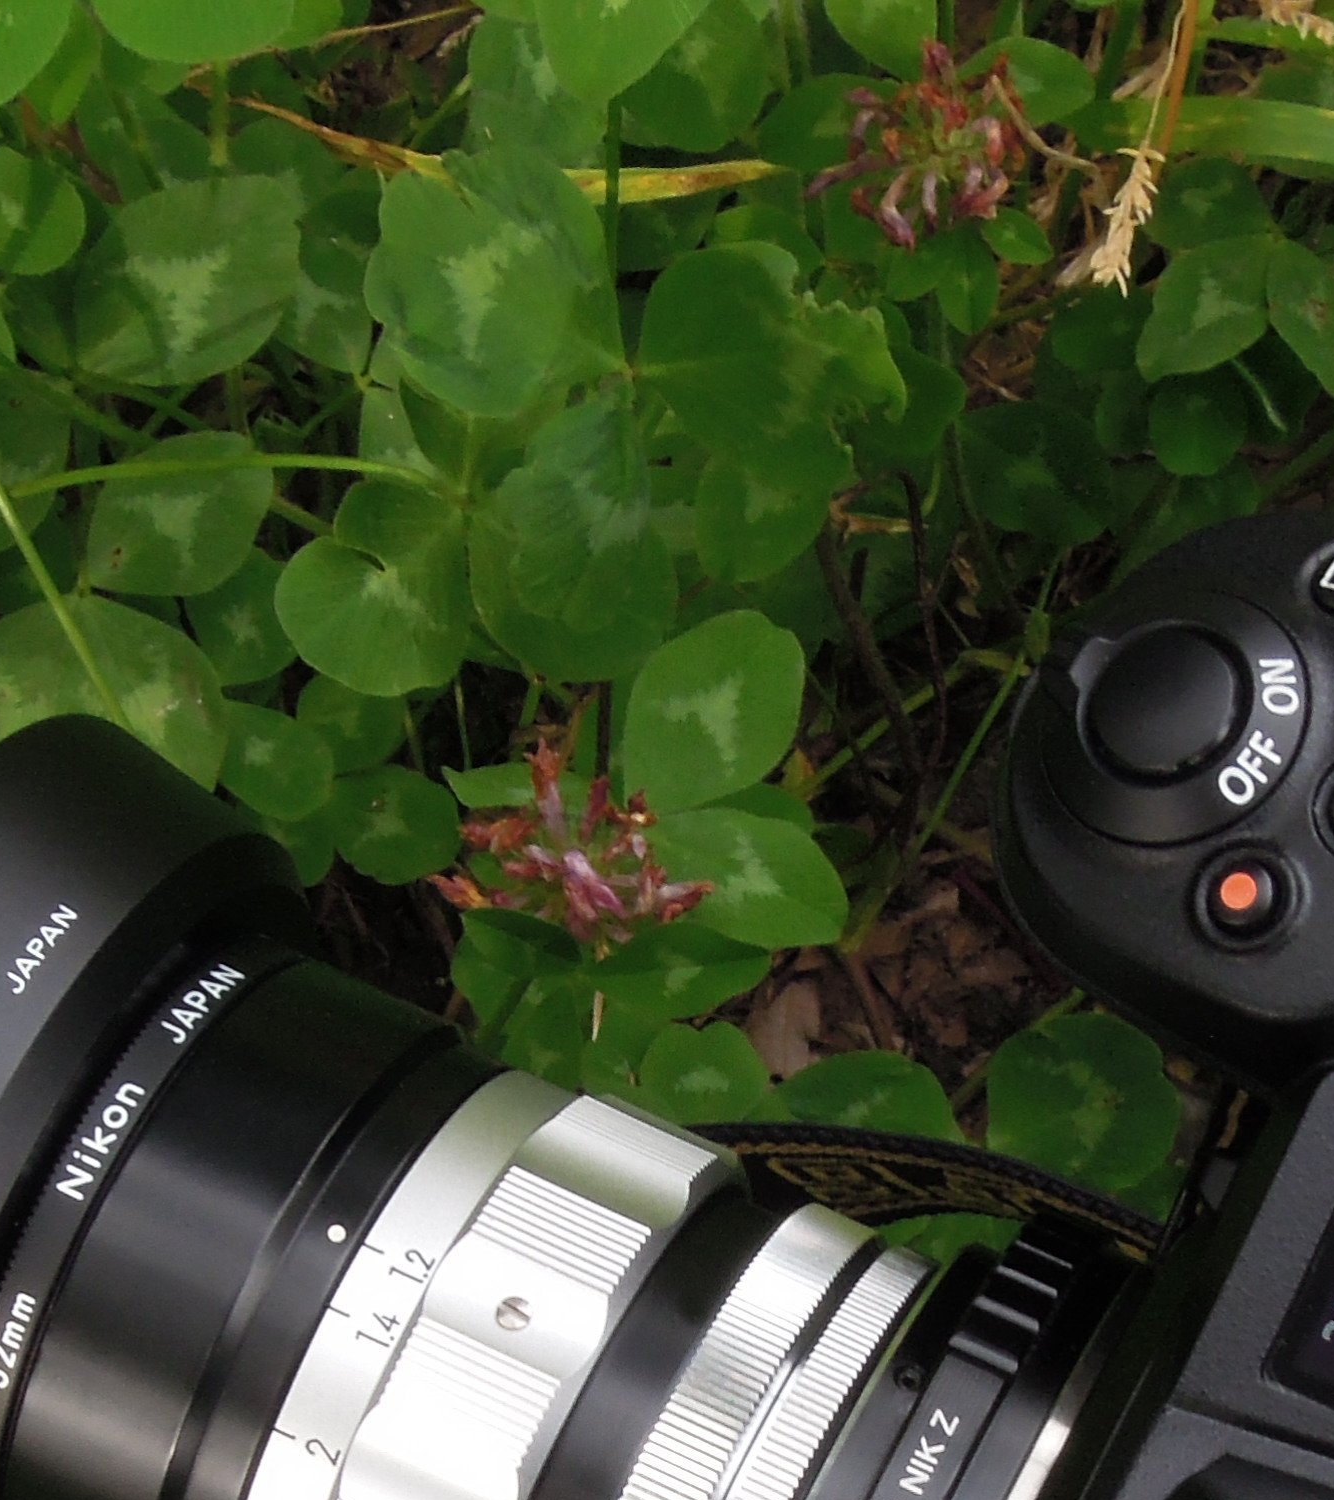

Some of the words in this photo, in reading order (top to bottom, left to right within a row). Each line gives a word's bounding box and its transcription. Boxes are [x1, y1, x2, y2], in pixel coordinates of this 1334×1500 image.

[1259, 658, 1300, 716] ON
[1218, 730, 1282, 805] OFF
[6, 904, 78, 995] JAPAN
[162, 963, 245, 1044] JAPAN
[55, 1082, 146, 1201] Nikon
[389, 1249, 436, 1284] 1.2
[356, 1312, 400, 1348] 1.4
[305, 1438, 341, 1466] 2
[899, 1436, 946, 1496] NIK
[929, 1408, 960, 1437] Z
